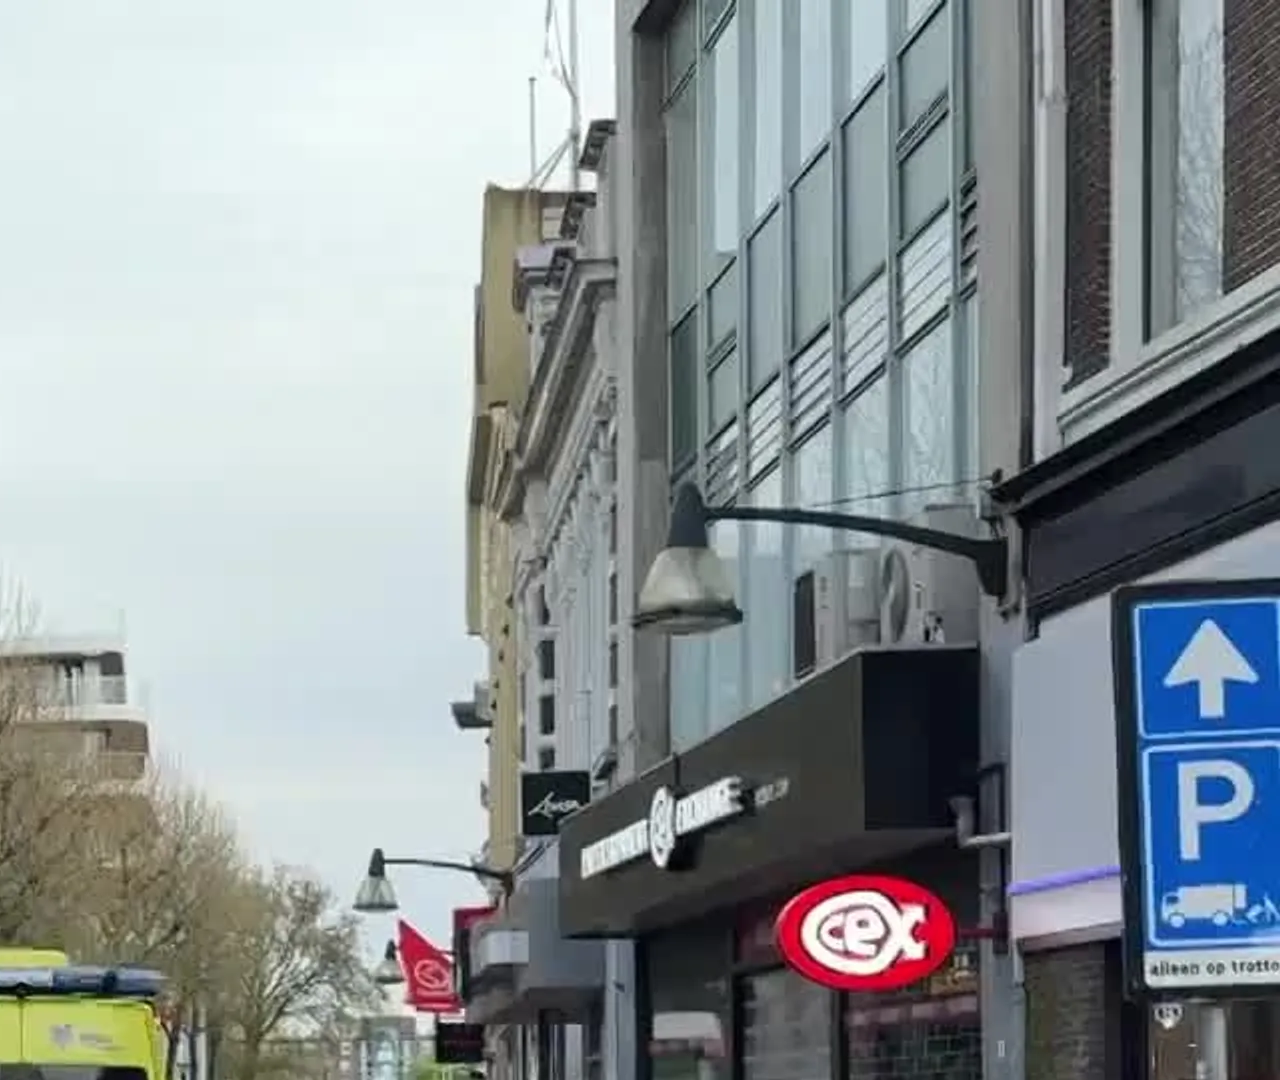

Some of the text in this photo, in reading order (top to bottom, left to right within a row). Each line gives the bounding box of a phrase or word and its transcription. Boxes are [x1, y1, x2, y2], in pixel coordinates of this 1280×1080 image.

[1177, 759, 1255, 861] P
[1150, 961, 1200, 977] alleen
[1206, 962, 1225, 976] op
